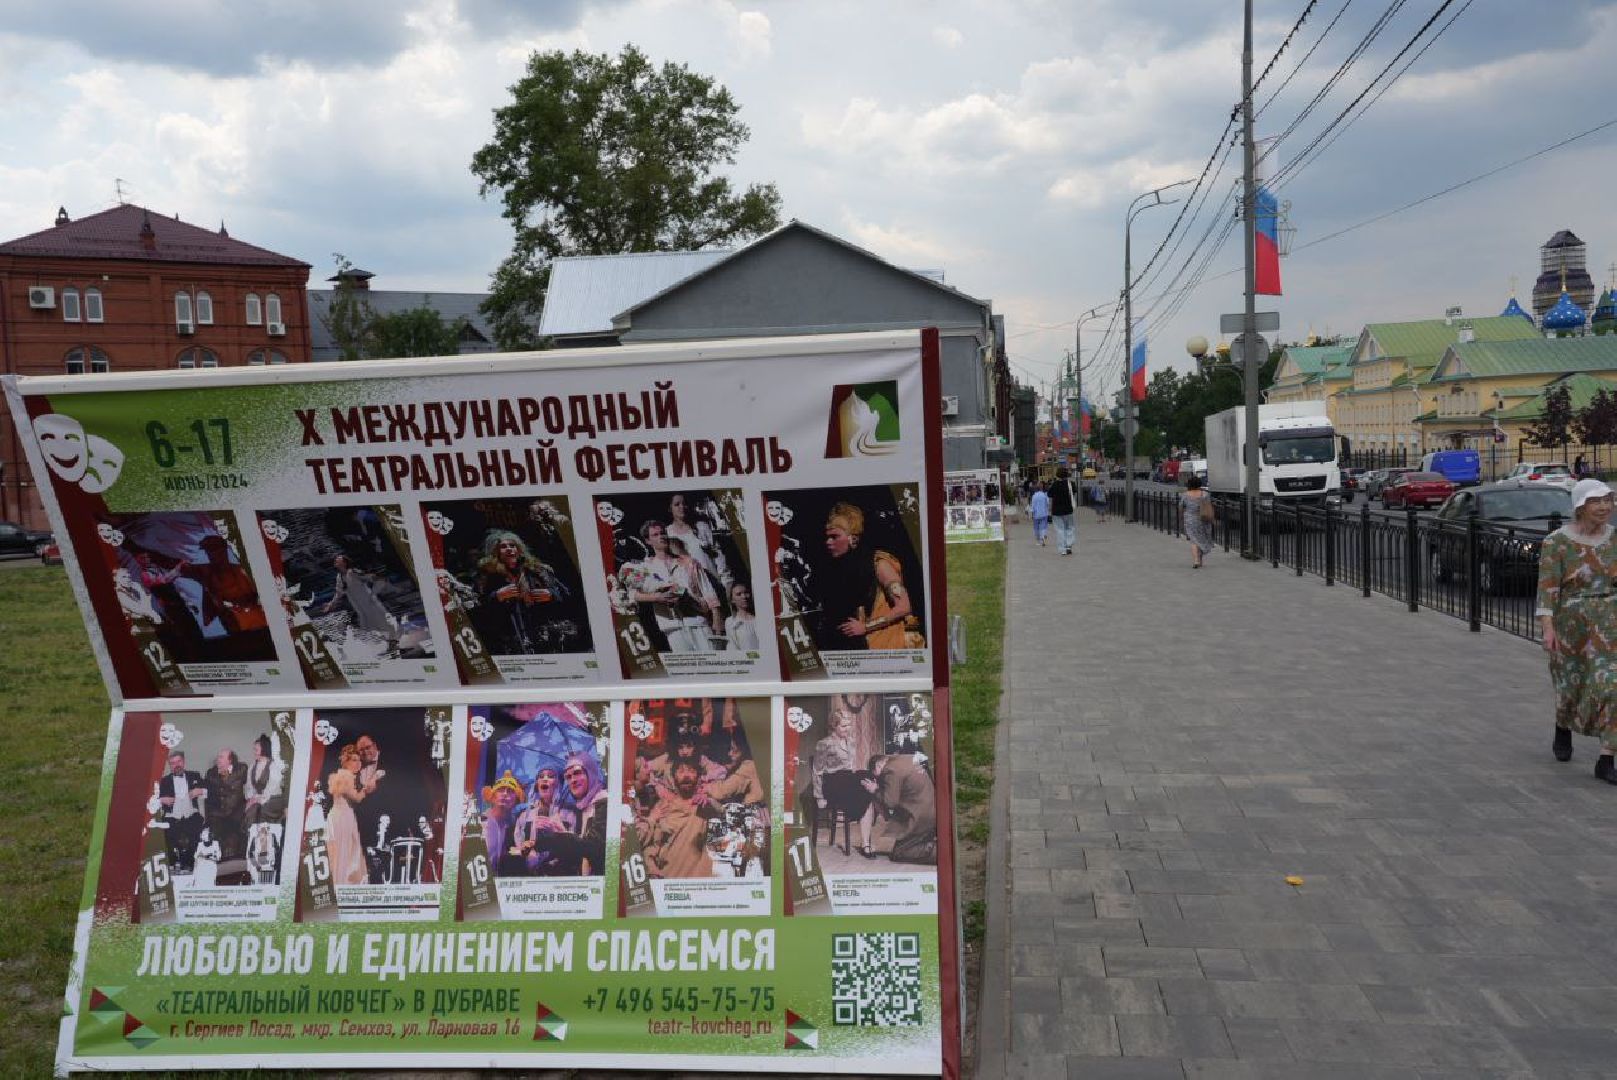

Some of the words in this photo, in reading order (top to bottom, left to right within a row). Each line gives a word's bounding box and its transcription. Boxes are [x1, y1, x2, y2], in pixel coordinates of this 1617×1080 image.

[331, 380, 680, 448] МЕЖДУНАРОДНЫЙ
[145, 418, 233, 468] 6-17
[305, 438, 563, 496] ТЕАТРАЛЬНЫЙ
[573, 436, 793, 482] ФЕСТИВАЛЬ
[295, 630, 325, 664] 12
[454, 626, 482, 659] 13
[620, 621, 651, 656] 13
[780, 618, 811, 654] 14
[144, 641, 171, 672] 12
[143, 852, 170, 894] 15
[303, 845, 330, 887] 15
[466, 854, 488, 887] 16
[622, 852, 646, 889] 16
[788, 835, 813, 877] 17
[136, 933, 314, 977] ЛЮБОВЬЮ
[326, 933, 350, 975] И
[361, 931, 574, 981] ЕДИНЕНИЕМ
[587, 928, 776, 972] СПАСЕМСЯ
[156, 985, 310, 1016] «ТЕАТРАЛЬНЫЙ
[317, 988, 405, 1014] КОВЧЕГ»
[413, 988, 425, 1013] В
[431, 988, 521, 1017] ДУБРАВЕ
[583, 987, 608, 1013] +7
[615, 986, 653, 1012] 496
[661, 986, 776, 1012] 545-75-75
[184, 1019, 244, 1039] Сергиев
[250, 1019, 295, 1039] Посад,
[338, 1018, 396, 1039] Семхоз,
[400, 1022, 422, 1040] ул.
[427, 1018, 499, 1038] Парковая
[504, 1018, 521, 1035] 16
[648, 1015, 773, 1039] teatr-kovcheg.ru
